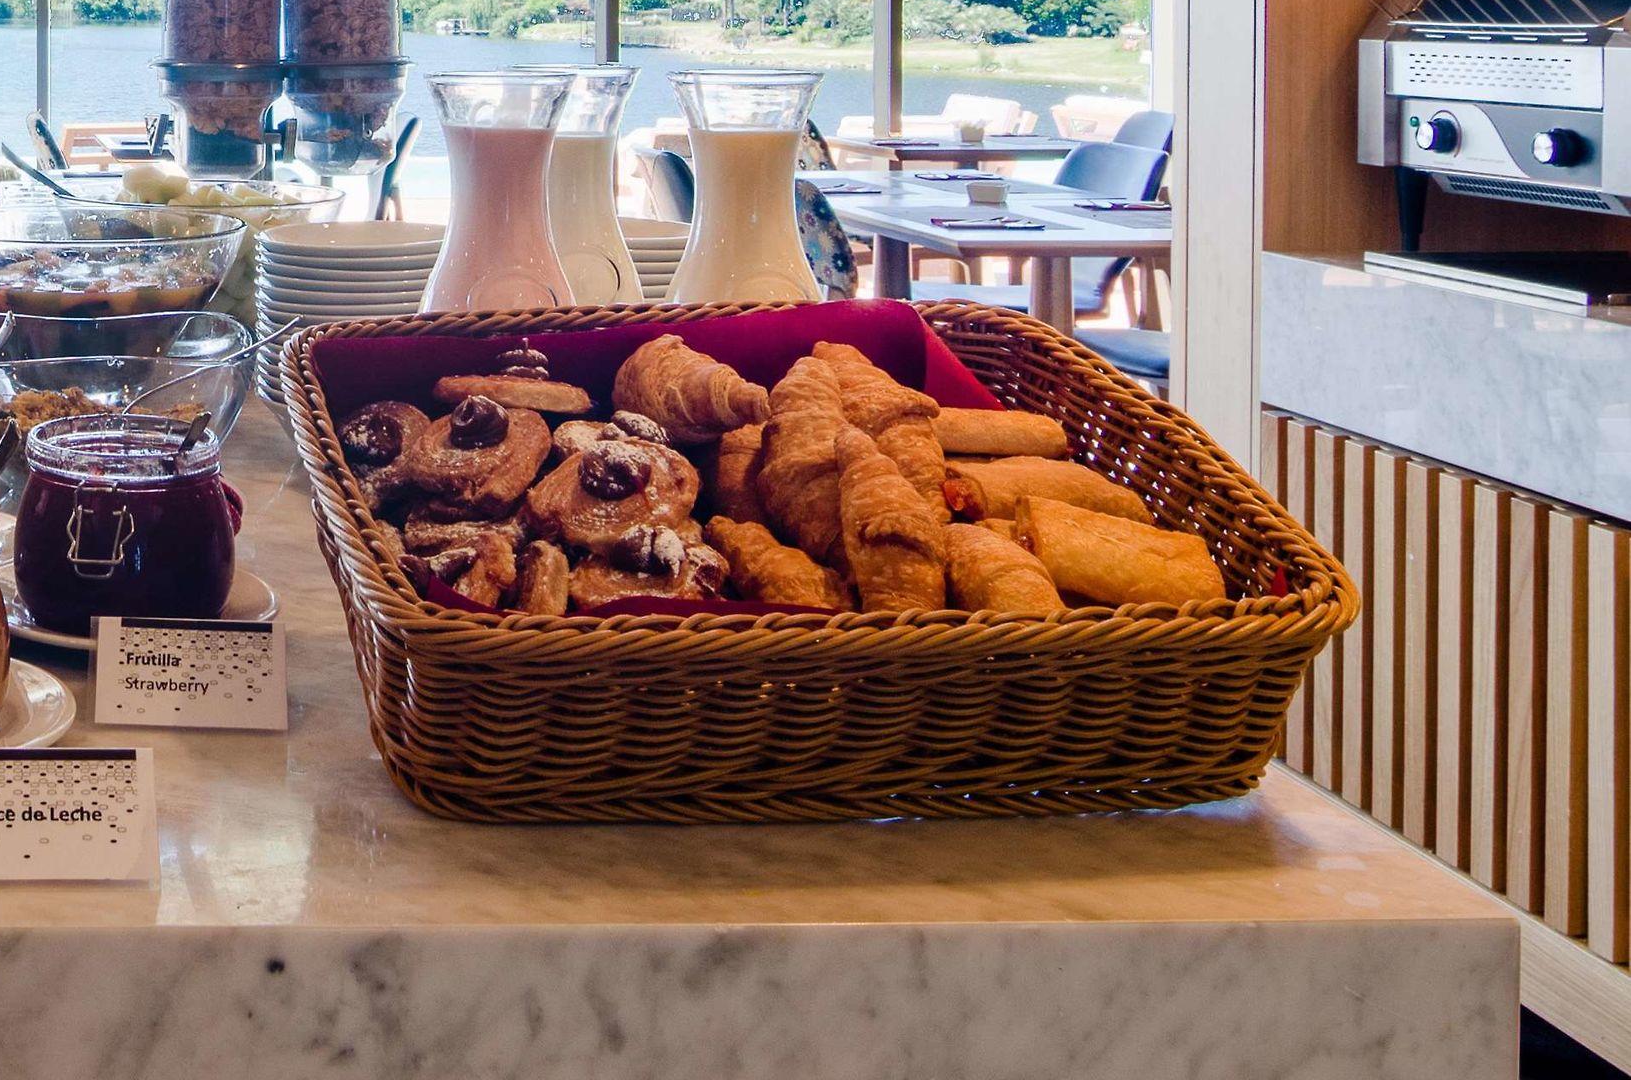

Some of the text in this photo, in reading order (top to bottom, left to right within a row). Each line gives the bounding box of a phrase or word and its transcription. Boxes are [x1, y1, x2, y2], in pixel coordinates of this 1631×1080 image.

[126, 652, 182, 668] Frutilla
[125, 677, 210, 695] Strawberry
[21, 806, 46, 822] de
[49, 806, 103, 822] Leche
